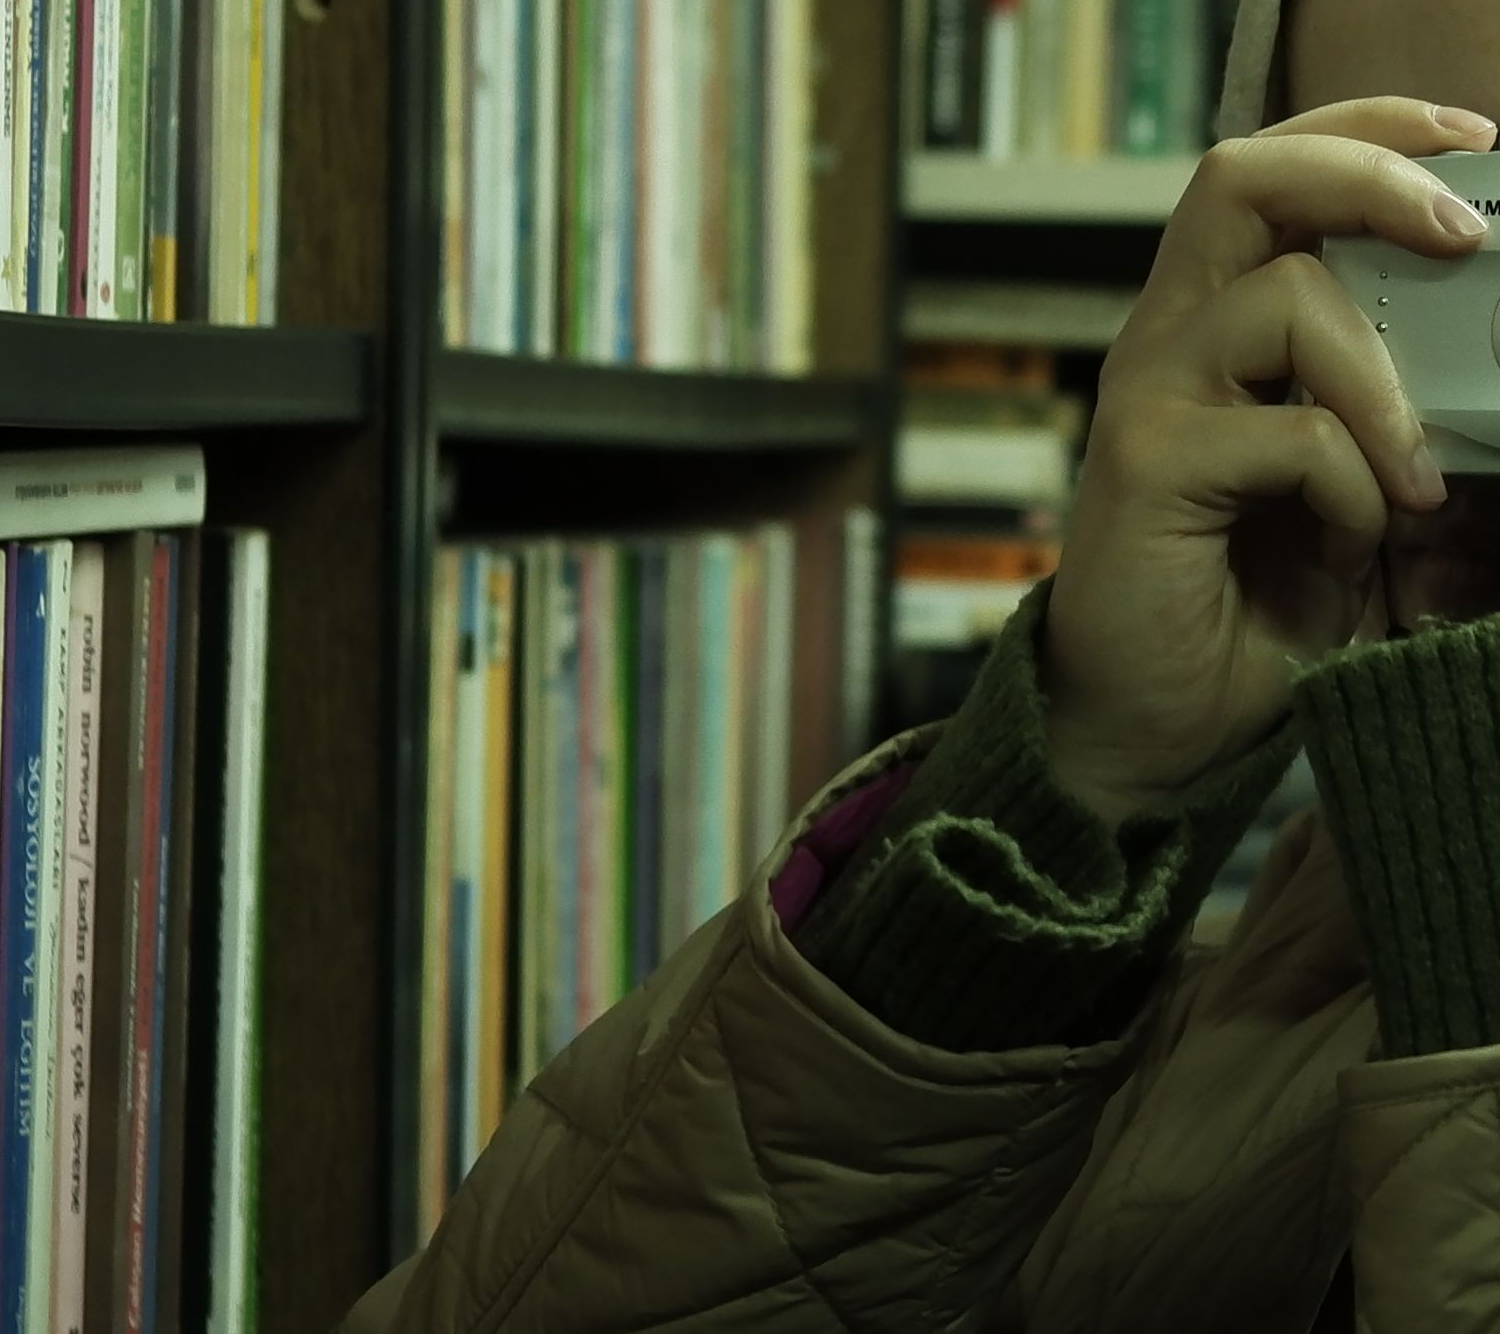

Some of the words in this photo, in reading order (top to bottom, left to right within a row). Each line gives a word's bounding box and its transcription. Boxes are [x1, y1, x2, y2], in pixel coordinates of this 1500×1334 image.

[81, 614, 95, 692] robin
[77, 710, 92, 845] norwood
[75, 876, 90, 960] kadın
[70, 972, 86, 1032] eğer
[70, 1044, 85, 1098] çok
[71, 1113, 82, 1214] severse
